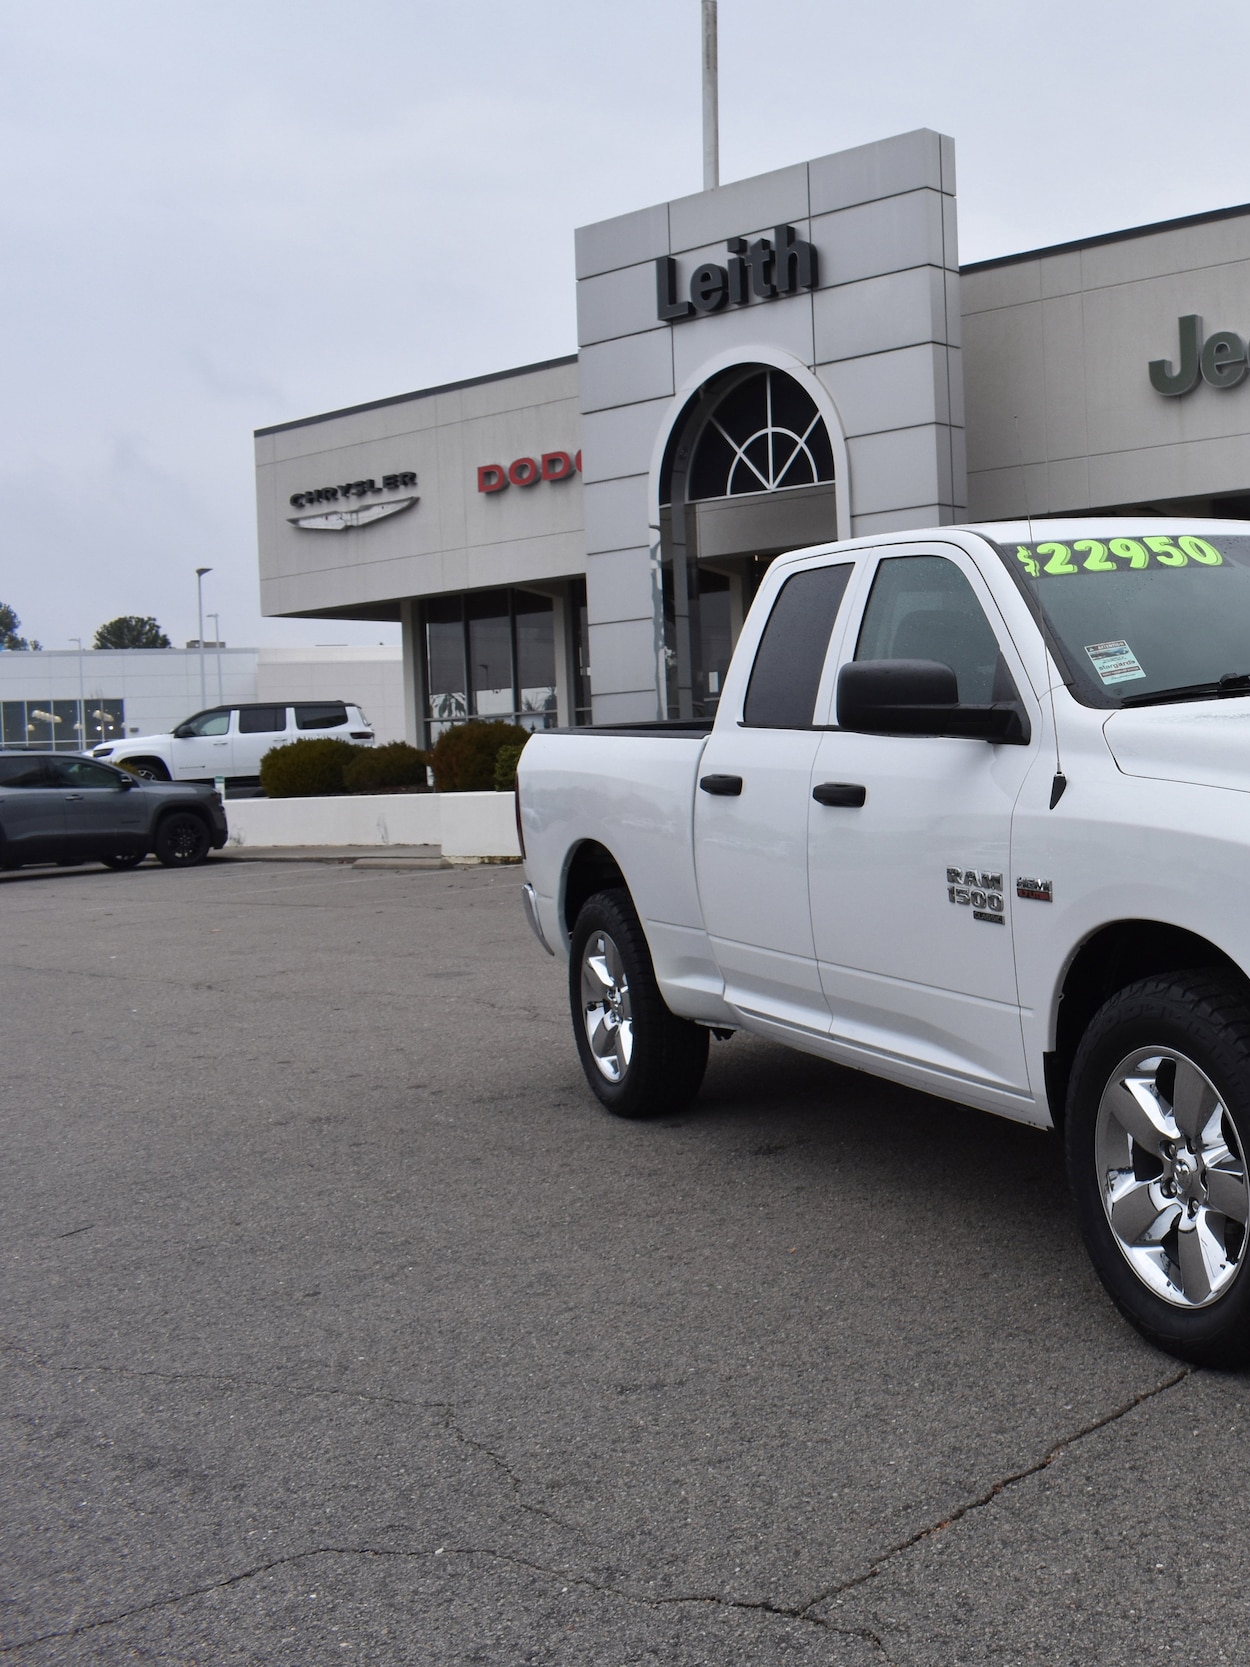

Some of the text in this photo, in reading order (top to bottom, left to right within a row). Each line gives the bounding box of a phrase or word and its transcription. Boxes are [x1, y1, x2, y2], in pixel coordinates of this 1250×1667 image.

[656, 224, 818, 322] Leith
[290, 471, 417, 508] CHRYSLER
[1017, 535, 1224, 577] $22950
[946, 865, 1004, 892] RAM
[947, 886, 1004, 912] 1500
